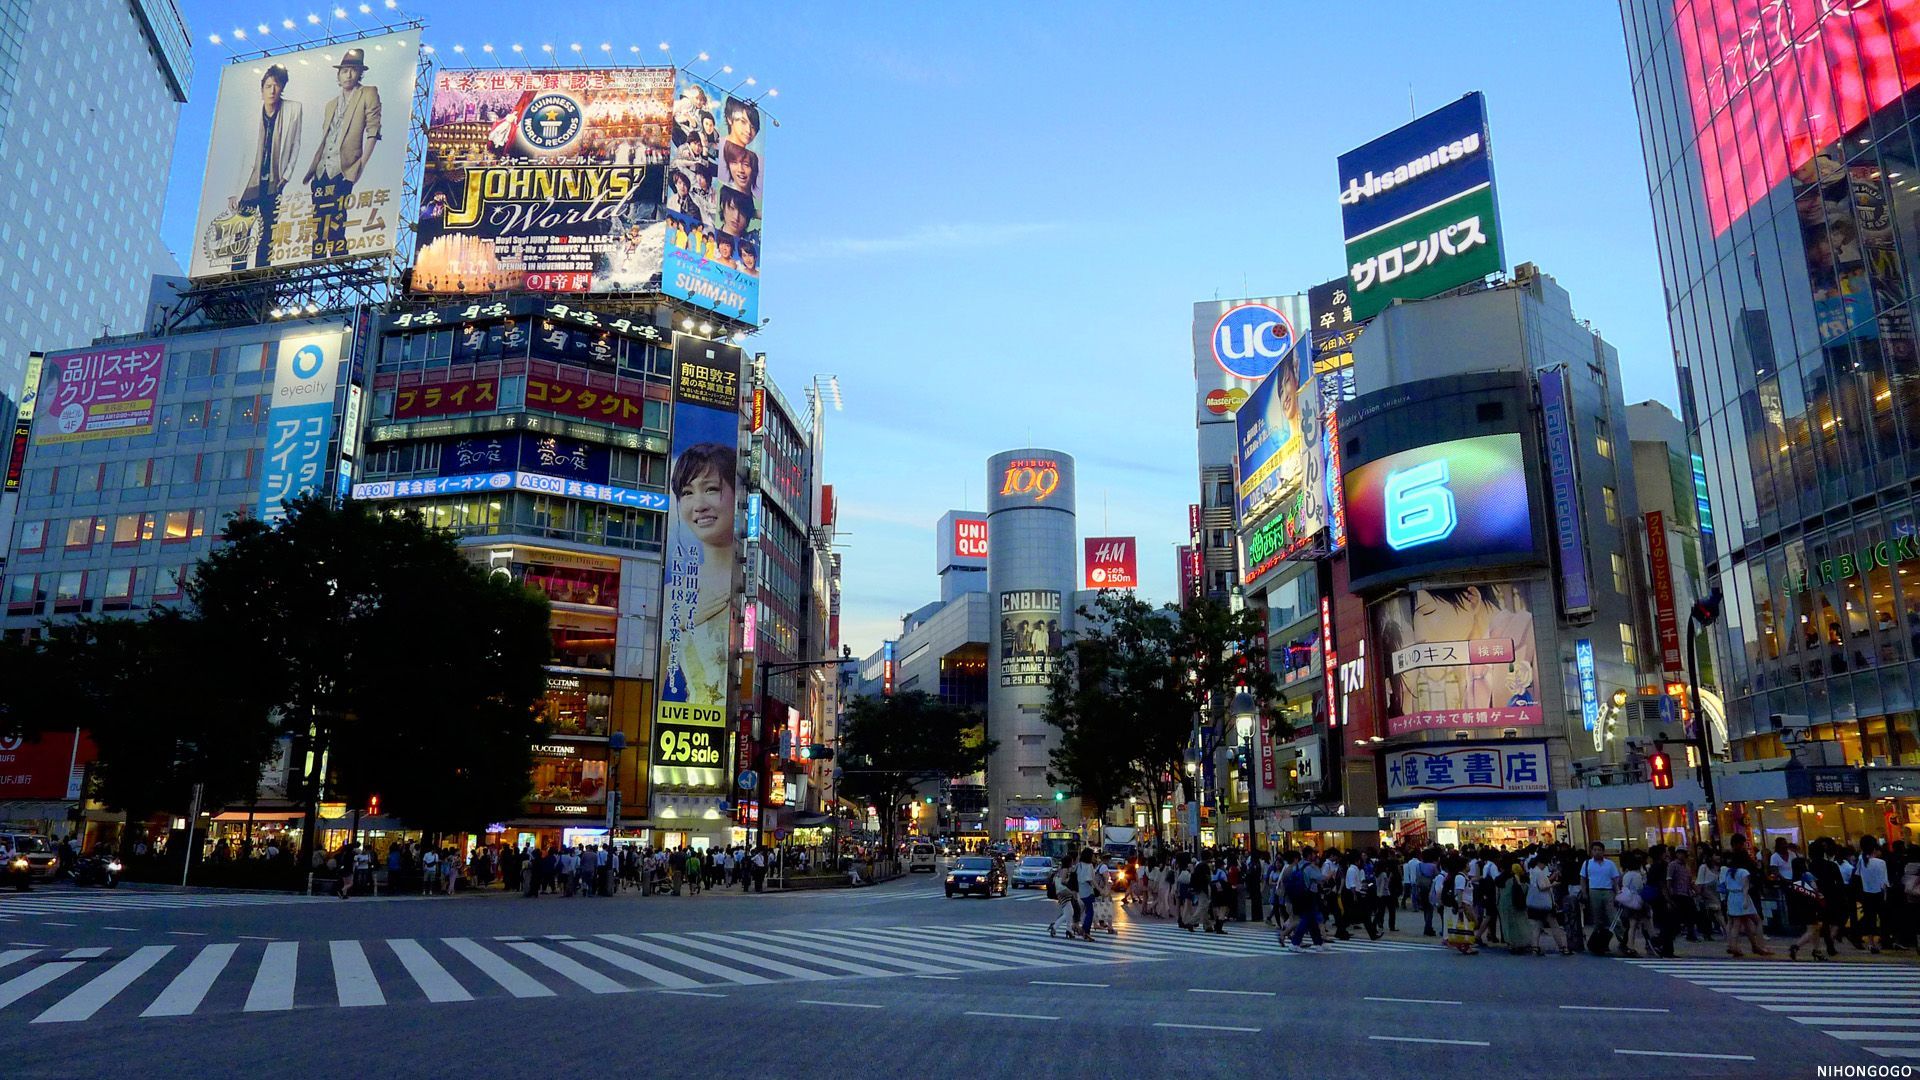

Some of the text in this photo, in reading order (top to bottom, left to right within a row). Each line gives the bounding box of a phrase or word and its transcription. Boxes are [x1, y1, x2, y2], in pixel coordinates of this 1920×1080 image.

[530, 97, 576, 114] GUINNESS
[524, 116, 579, 147] WORLD RECORDS
[1338, 132, 1480, 204] Hisamitsu
[274, 189, 390, 221] デビュー10周年
[489, 184, 640, 236] World
[268, 208, 386, 248] 東京ドーム
[1350, 216, 1487, 291] サロンパス
[497, 263, 527, 271] OPENING
[528, 263, 536, 271] IN
[537, 262, 574, 271] NOVEMBER
[575, 262, 594, 270] 2012
[552, 274, 590, 290] 帝劇
[676, 273, 747, 310] SUMMARY
[1332, 289, 1348, 305] あ
[63, 351, 161, 383] 品川スキン
[681, 363, 736, 386] 前田敦子
[60, 374, 157, 407] クリニック
[280, 382, 328, 398] eyecity
[400, 382, 495, 412] プライス
[528, 381, 639, 418] コンタクト
[64, 421, 77, 430] 4F
[505, 418, 515, 426] 7F
[527, 418, 538, 426] 7F
[1010, 459, 1058, 470] SHIBUYA
[1546, 396, 1575, 550] Taisei neon
[356, 485, 390, 498] AEON
[397, 476, 485, 496] 英会話イーオン
[520, 473, 561, 491] AEON
[1000, 466, 1059, 500] 109
[567, 480, 667, 509] 英会話イーオン
[1385, 458, 1458, 551] 6
[959, 524, 985, 537] UNI
[959, 539, 987, 554] QLO
[1095, 543, 1126, 563] H&M
[1650, 515, 1670, 601] クスリのことなら
[1782, 532, 1920, 598] STARBUCK
[1107, 574, 1131, 583] 150m
[1001, 592, 1060, 611] CNBLUE
[1659, 608, 1679, 663] 三千里
[1478, 644, 1504, 657] 検索
[1021, 662, 1042, 673] NAME
[1025, 674, 1036, 684] ON
[1578, 644, 1597, 725] 大盛堂商事ビル
[662, 707, 721, 722] LIVE DVD
[660, 730, 709, 762] 9.5 on
[691, 746, 720, 763] sale
[823, 738, 834, 791] マナン
[1390, 752, 1537, 788] 大盛堂書店
[1816, 782, 1843, 793] 渋谷駅
